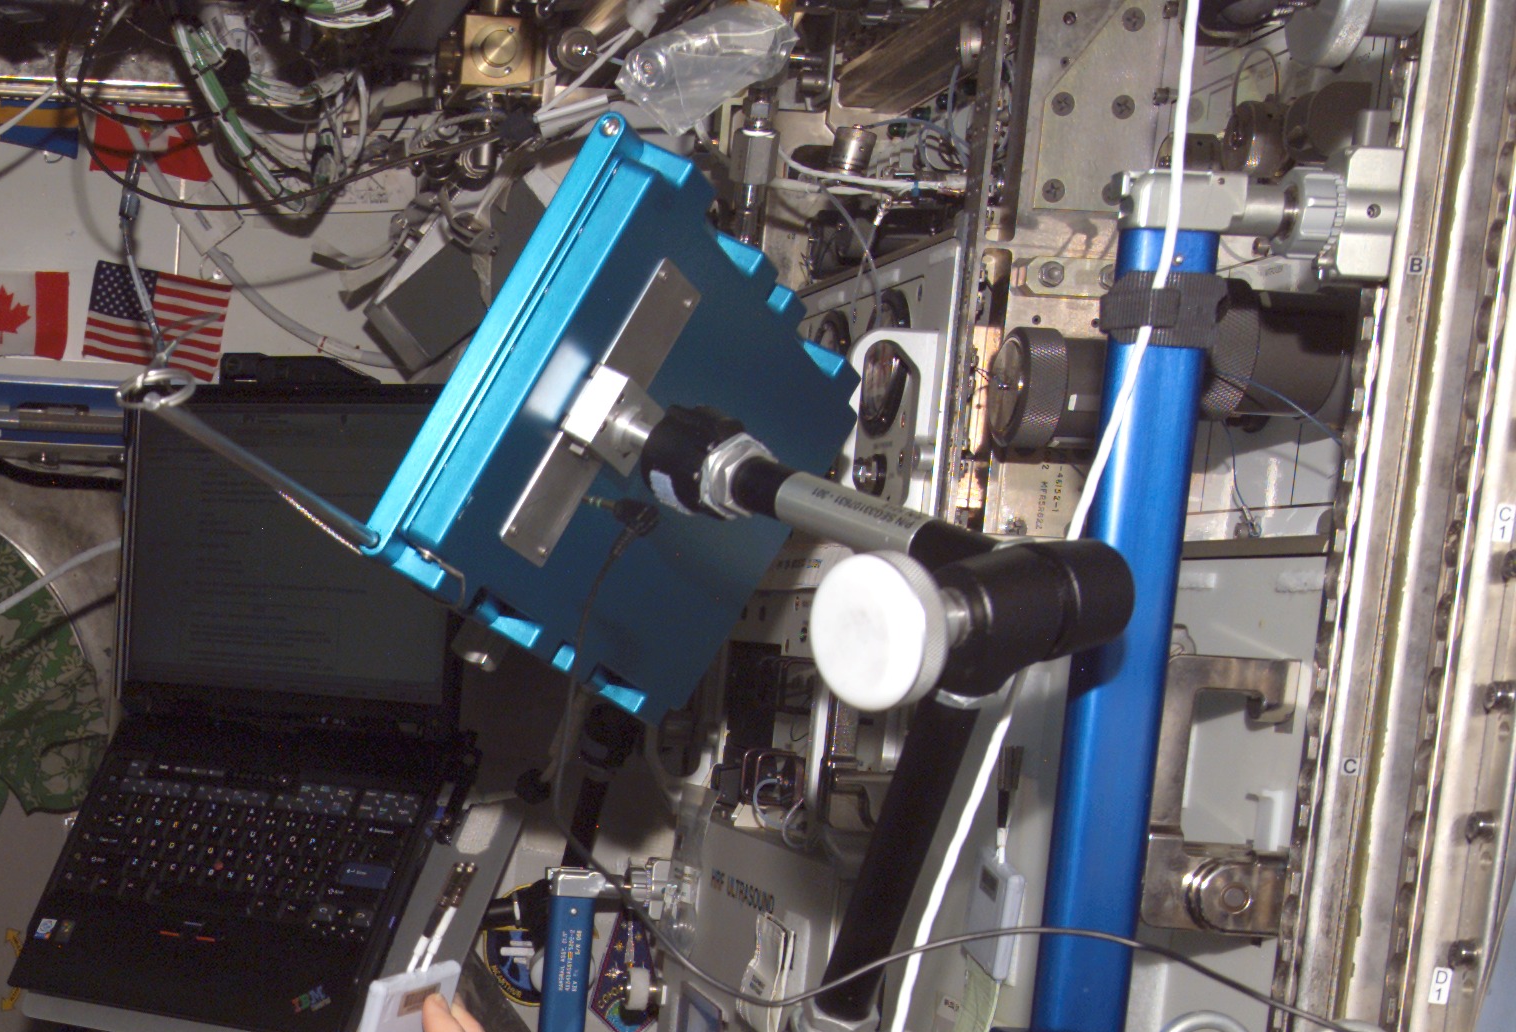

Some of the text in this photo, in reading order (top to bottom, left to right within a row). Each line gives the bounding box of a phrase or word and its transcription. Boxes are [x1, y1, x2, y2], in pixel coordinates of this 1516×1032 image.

[1410, 257, 1423, 273] B
[1499, 506, 1512, 522] C
[1499, 525, 1506, 540] 1
[1344, 758, 1357, 774] C
[726, 875, 775, 914] ULTRASOUND
[1435, 970, 1448, 984] D
[1436, 988, 1442, 1001] 1
